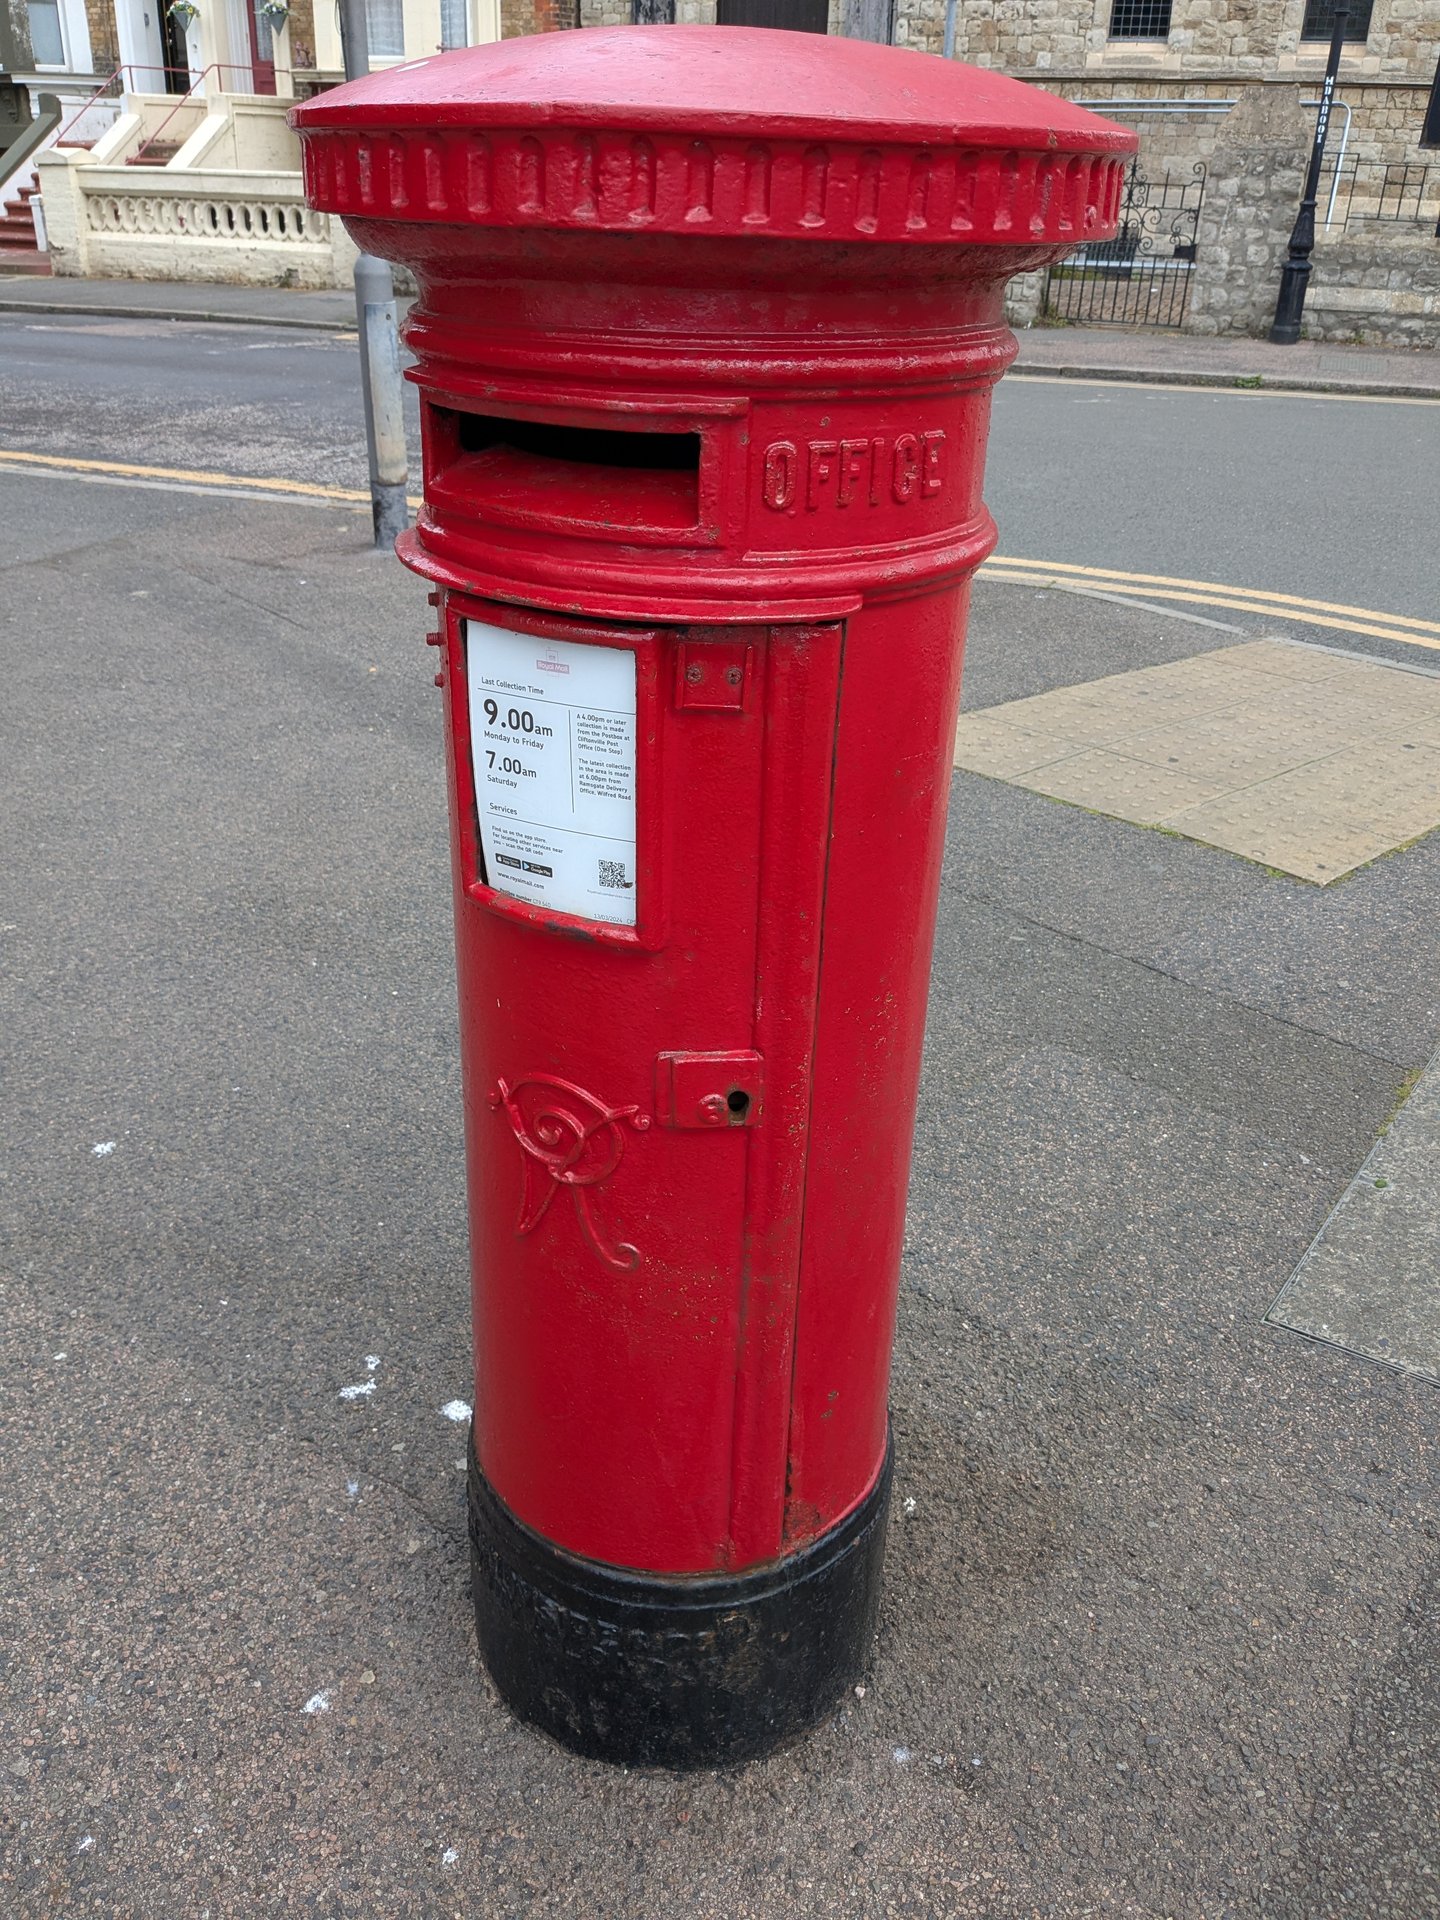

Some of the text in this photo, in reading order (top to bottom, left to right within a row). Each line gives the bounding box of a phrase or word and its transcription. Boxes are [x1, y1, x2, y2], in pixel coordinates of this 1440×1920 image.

[763, 429, 946, 512] OFFICE
[538, 661, 568, 673] Royal Mail
[481, 676, 544, 695] Last Collection Time
[484, 698, 553, 737] 9.00am
[582, 714, 605, 723] 4.00pm
[577, 722, 602, 730] collection
[484, 730, 544, 750] Monday to Friday
[578, 736, 606, 746] Cliftonville
[602, 732, 622, 740] Postbox
[608, 748, 623, 756] Stop)
[485, 750, 537, 778] 7.00am
[487, 774, 518, 788] Saturday
[586, 774, 607, 782] 6.00pm
[579, 780, 628, 793] Ramsgate Delivery
[597, 790, 616, 798] Wilfred
[490, 802, 518, 815] Services
[500, 834, 518, 843] locating
[532, 843, 551, 851] services
[497, 872, 544, 890] www.royalmail.com
